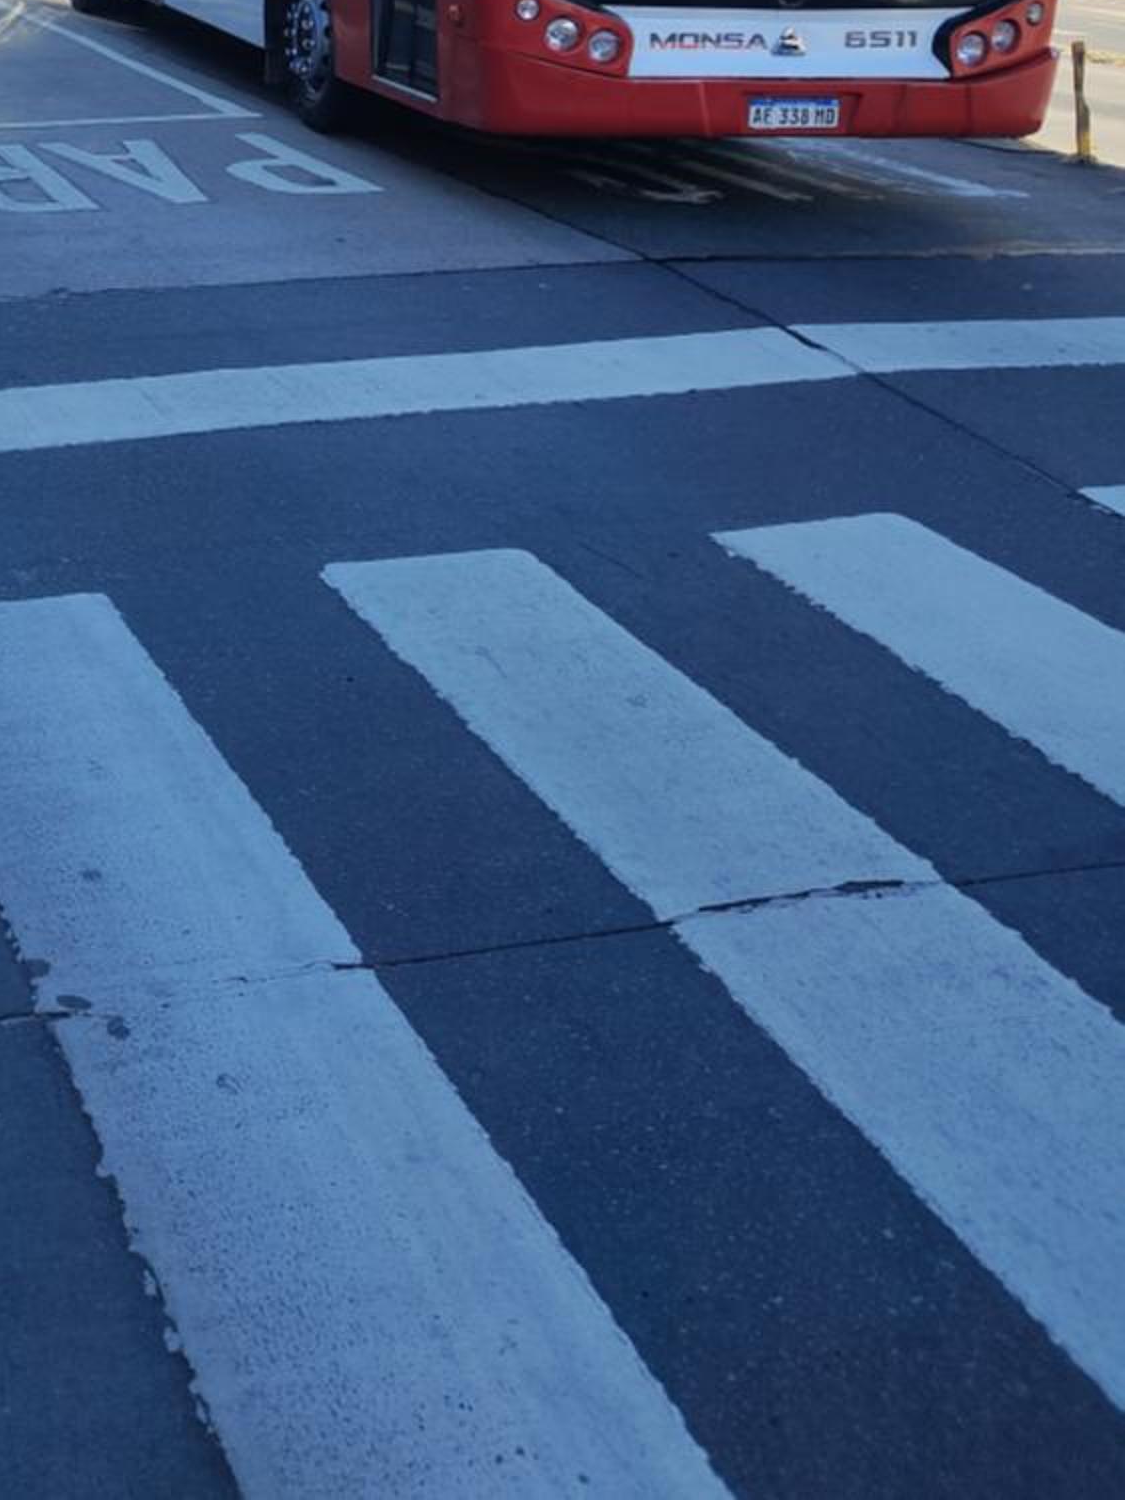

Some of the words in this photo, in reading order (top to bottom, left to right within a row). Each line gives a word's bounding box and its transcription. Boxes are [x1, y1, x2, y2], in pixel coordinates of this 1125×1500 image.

[649, 33, 768, 50] MONSA
[844, 31, 918, 49] 6511
[752, 108, 771, 125] AE
[778, 108, 808, 126] 338
[814, 108, 835, 125] MD
